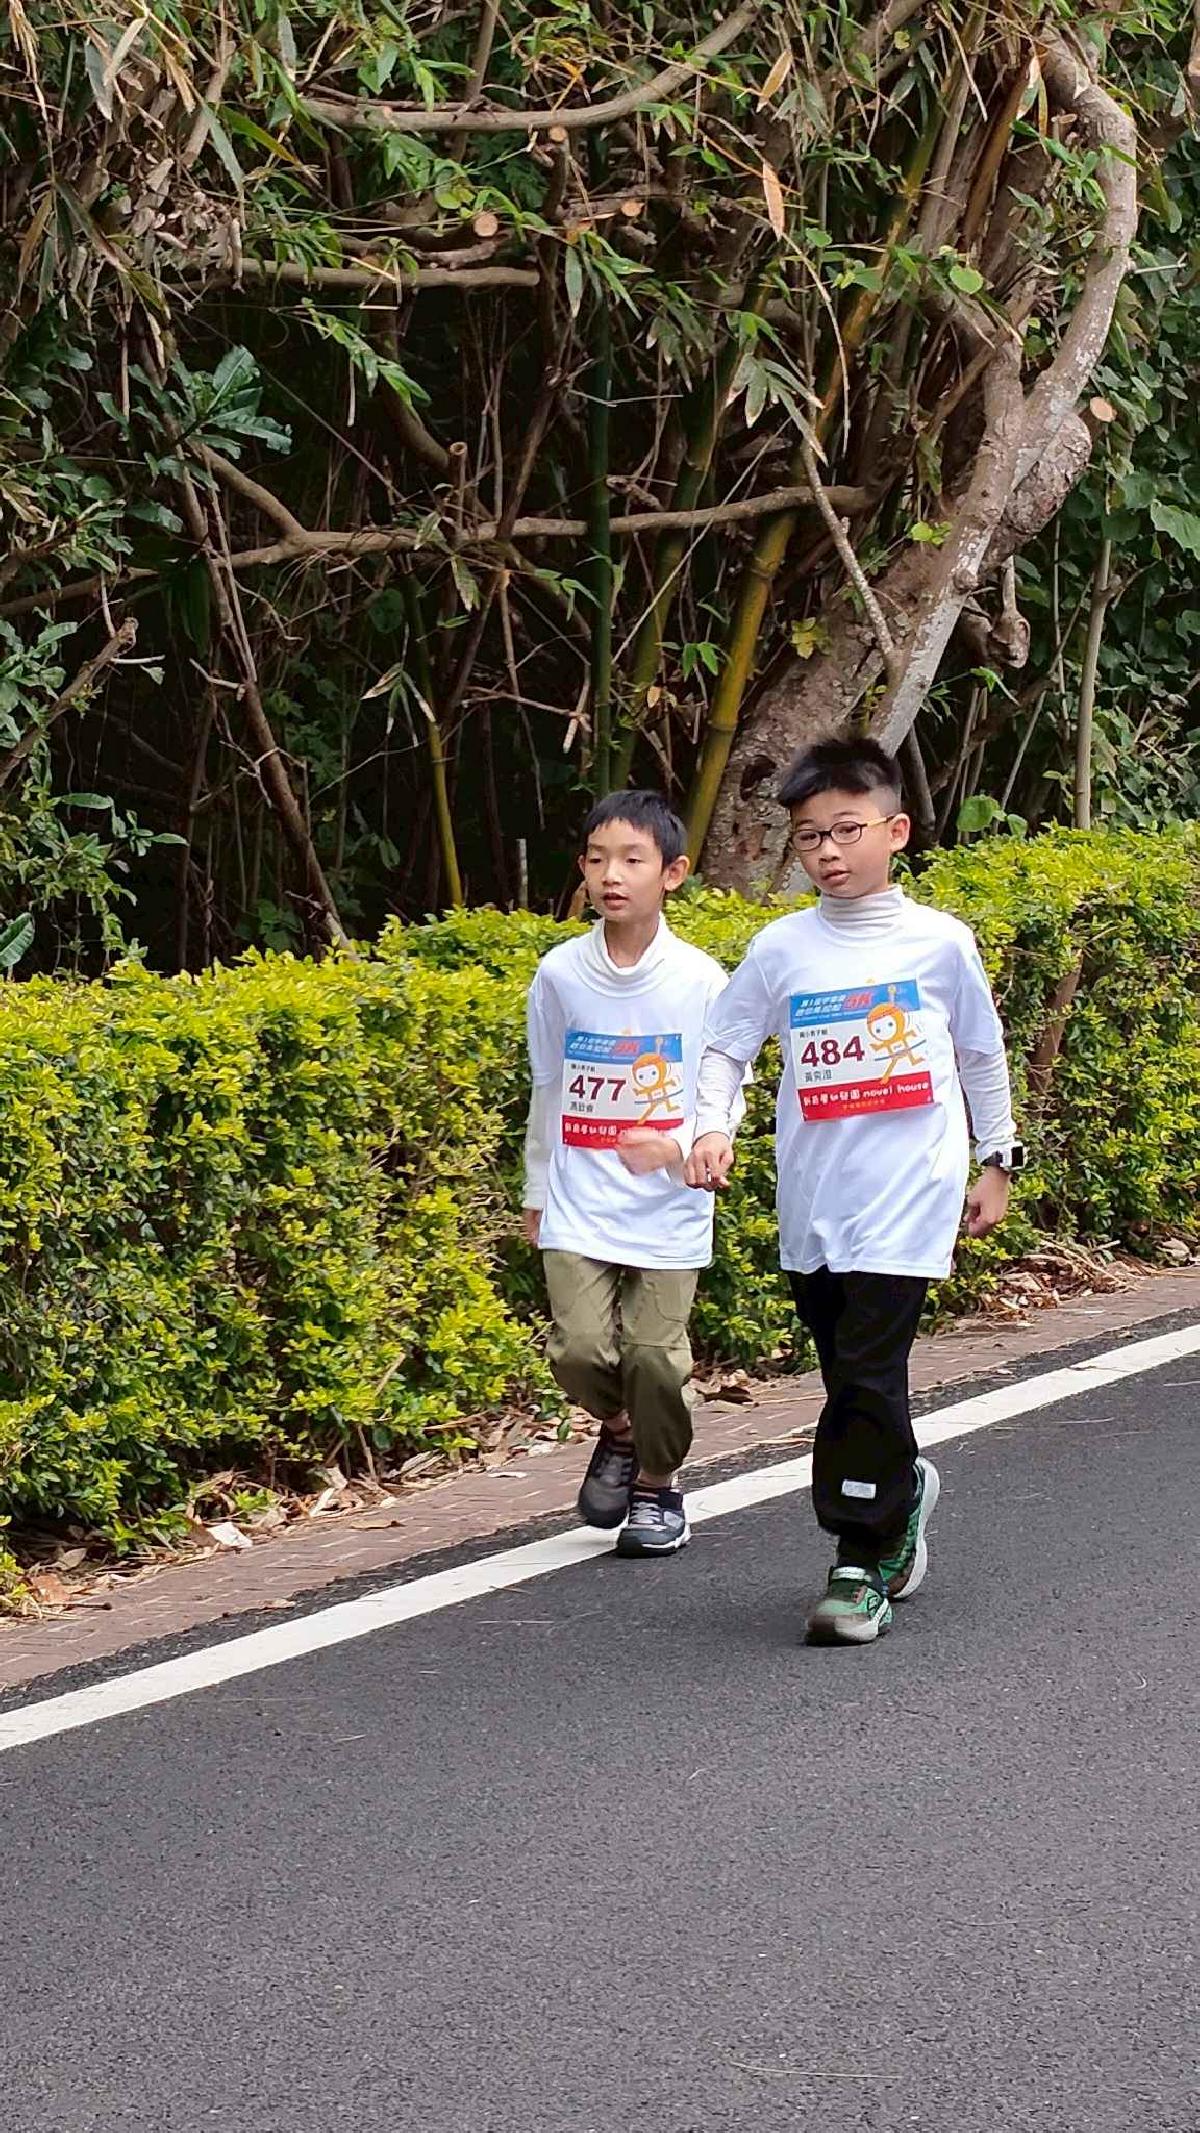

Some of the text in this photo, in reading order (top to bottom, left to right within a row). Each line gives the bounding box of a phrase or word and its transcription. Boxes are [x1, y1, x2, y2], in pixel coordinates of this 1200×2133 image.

[801, 1035, 865, 1067] 484
[569, 1074, 626, 1101] 477
[863, 1085, 893, 1099] novel
[897, 1081, 929, 1094] house
